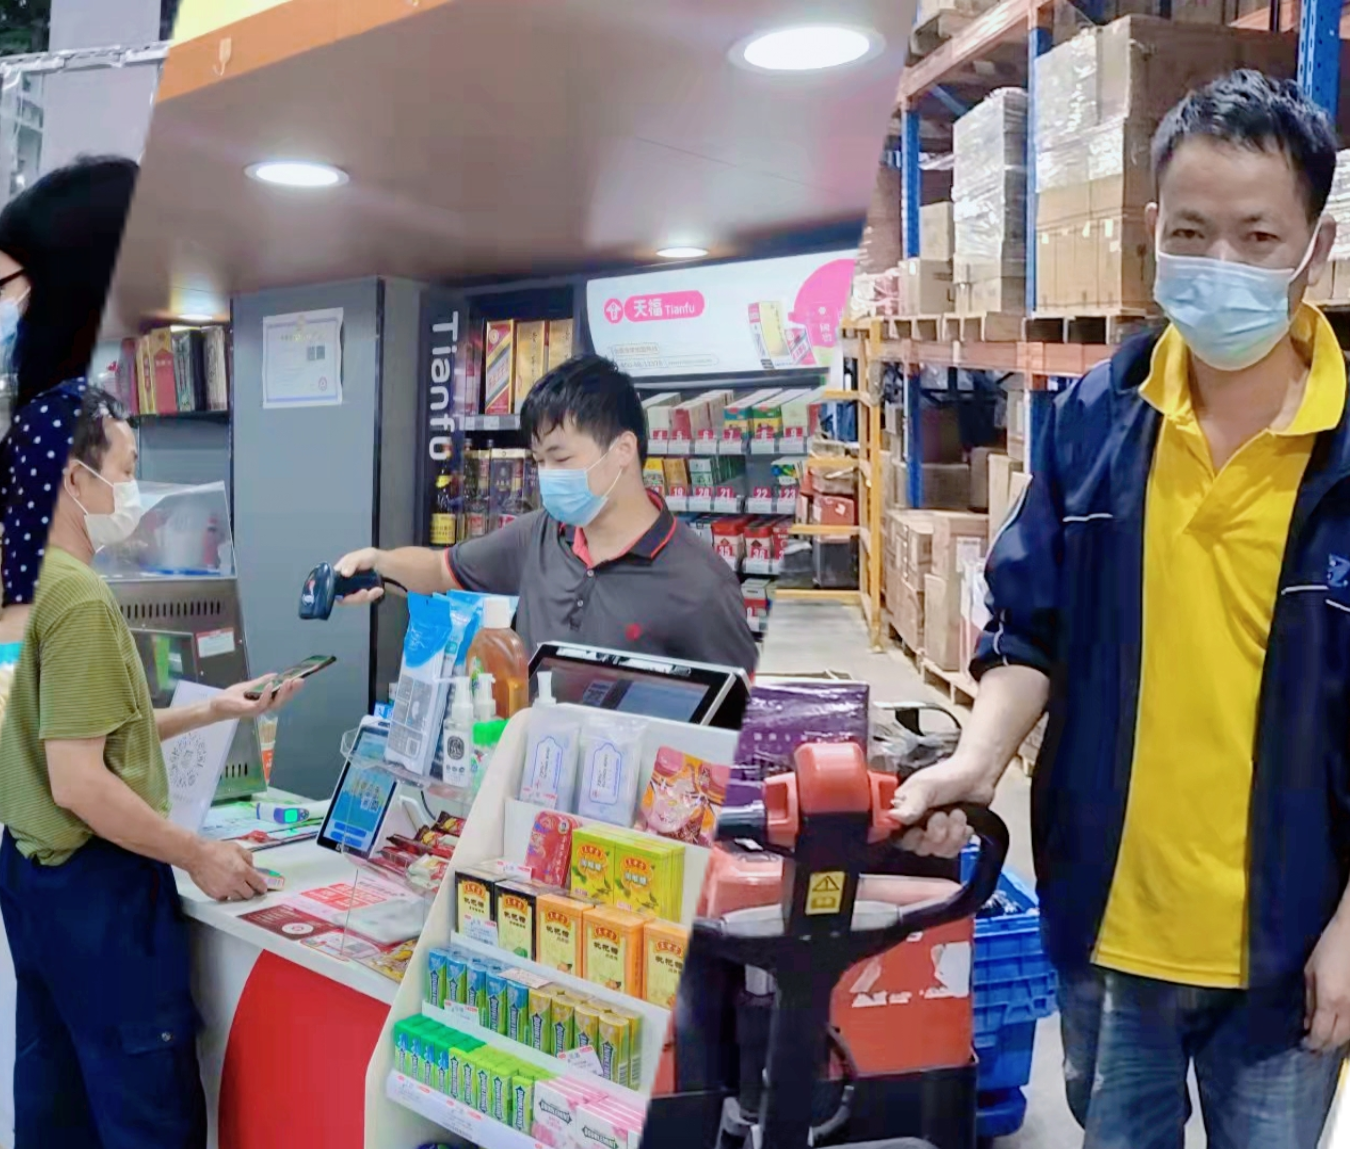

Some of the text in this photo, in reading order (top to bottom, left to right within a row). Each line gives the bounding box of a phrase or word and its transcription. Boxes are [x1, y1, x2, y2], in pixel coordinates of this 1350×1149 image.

[633, 298, 696, 317] 天福 Tianfu
[429, 311, 458, 461] Tianfu
[673, 487, 683, 497] 19
[698, 487, 710, 497] 20
[720, 487, 731, 498] 21
[756, 487, 768, 498] 22
[783, 488, 796, 499] 23
[719, 545, 730, 557] 35
[593, 942, 619, 955] 枇杷糖
[516, 1090, 524, 1127] DOUBLEMINT
